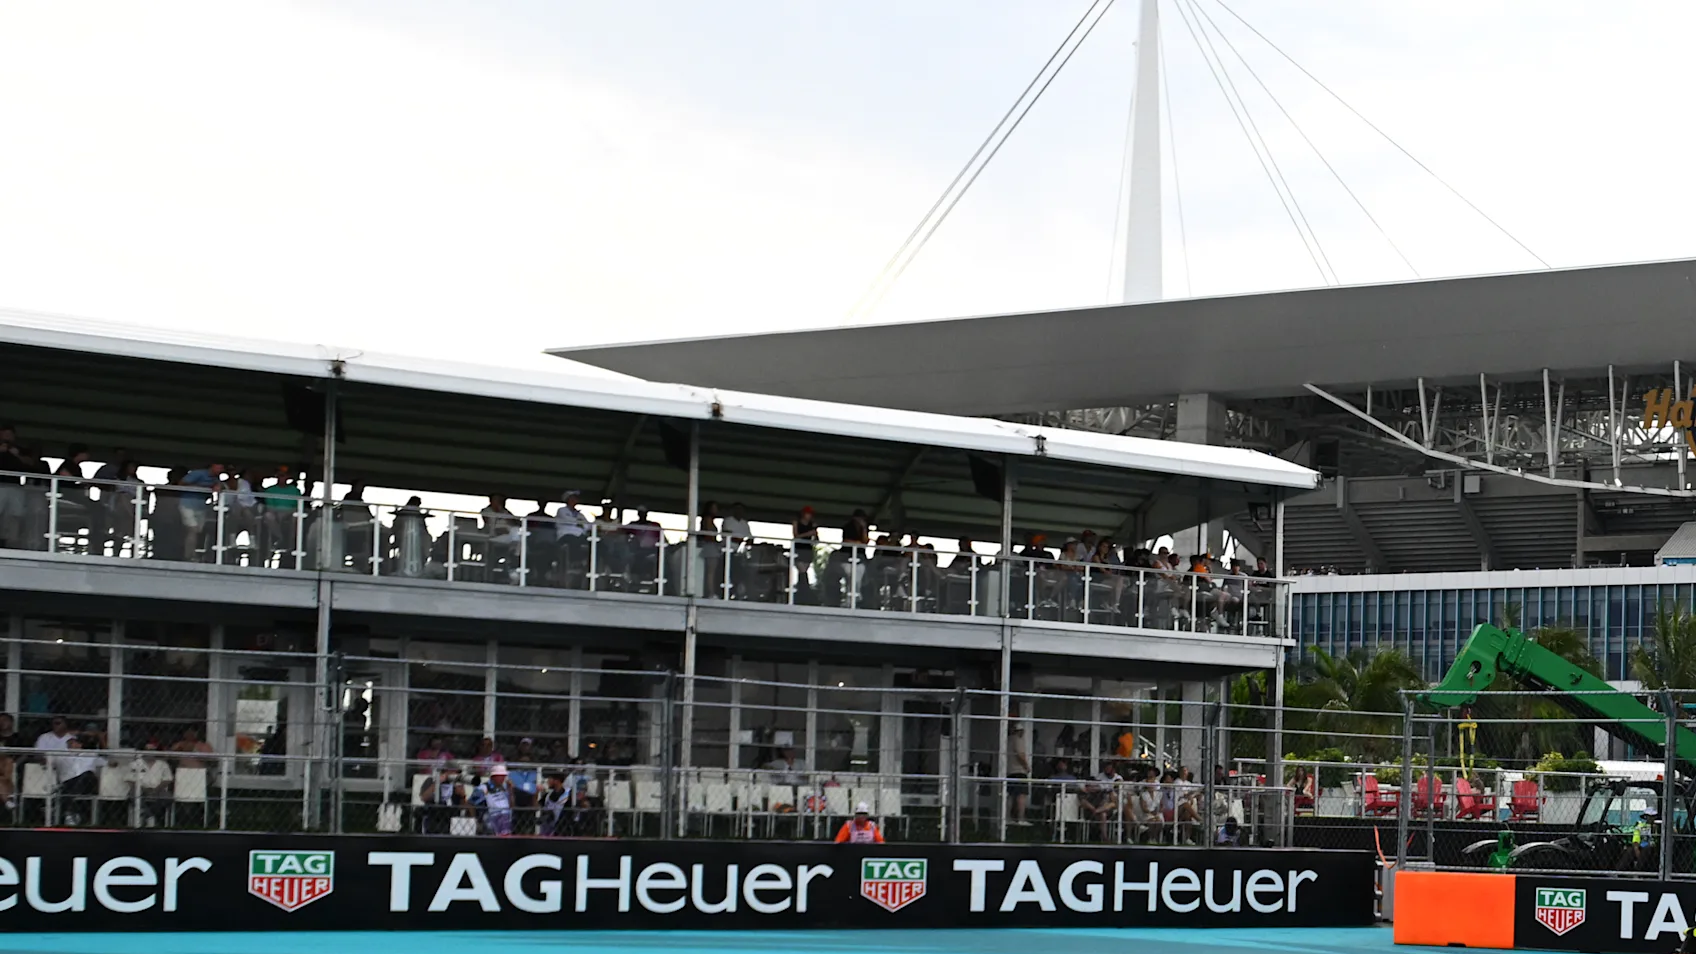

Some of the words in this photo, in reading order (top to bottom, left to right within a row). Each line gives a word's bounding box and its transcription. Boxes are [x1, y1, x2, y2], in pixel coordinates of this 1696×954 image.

[256, 854, 326, 874] TAG
[867, 862, 921, 879] TAG
[254, 878, 329, 907] HEUER
[865, 882, 923, 907] HEUER
[1540, 891, 1581, 907] TAG
[1538, 908, 1582, 931] HEUER
